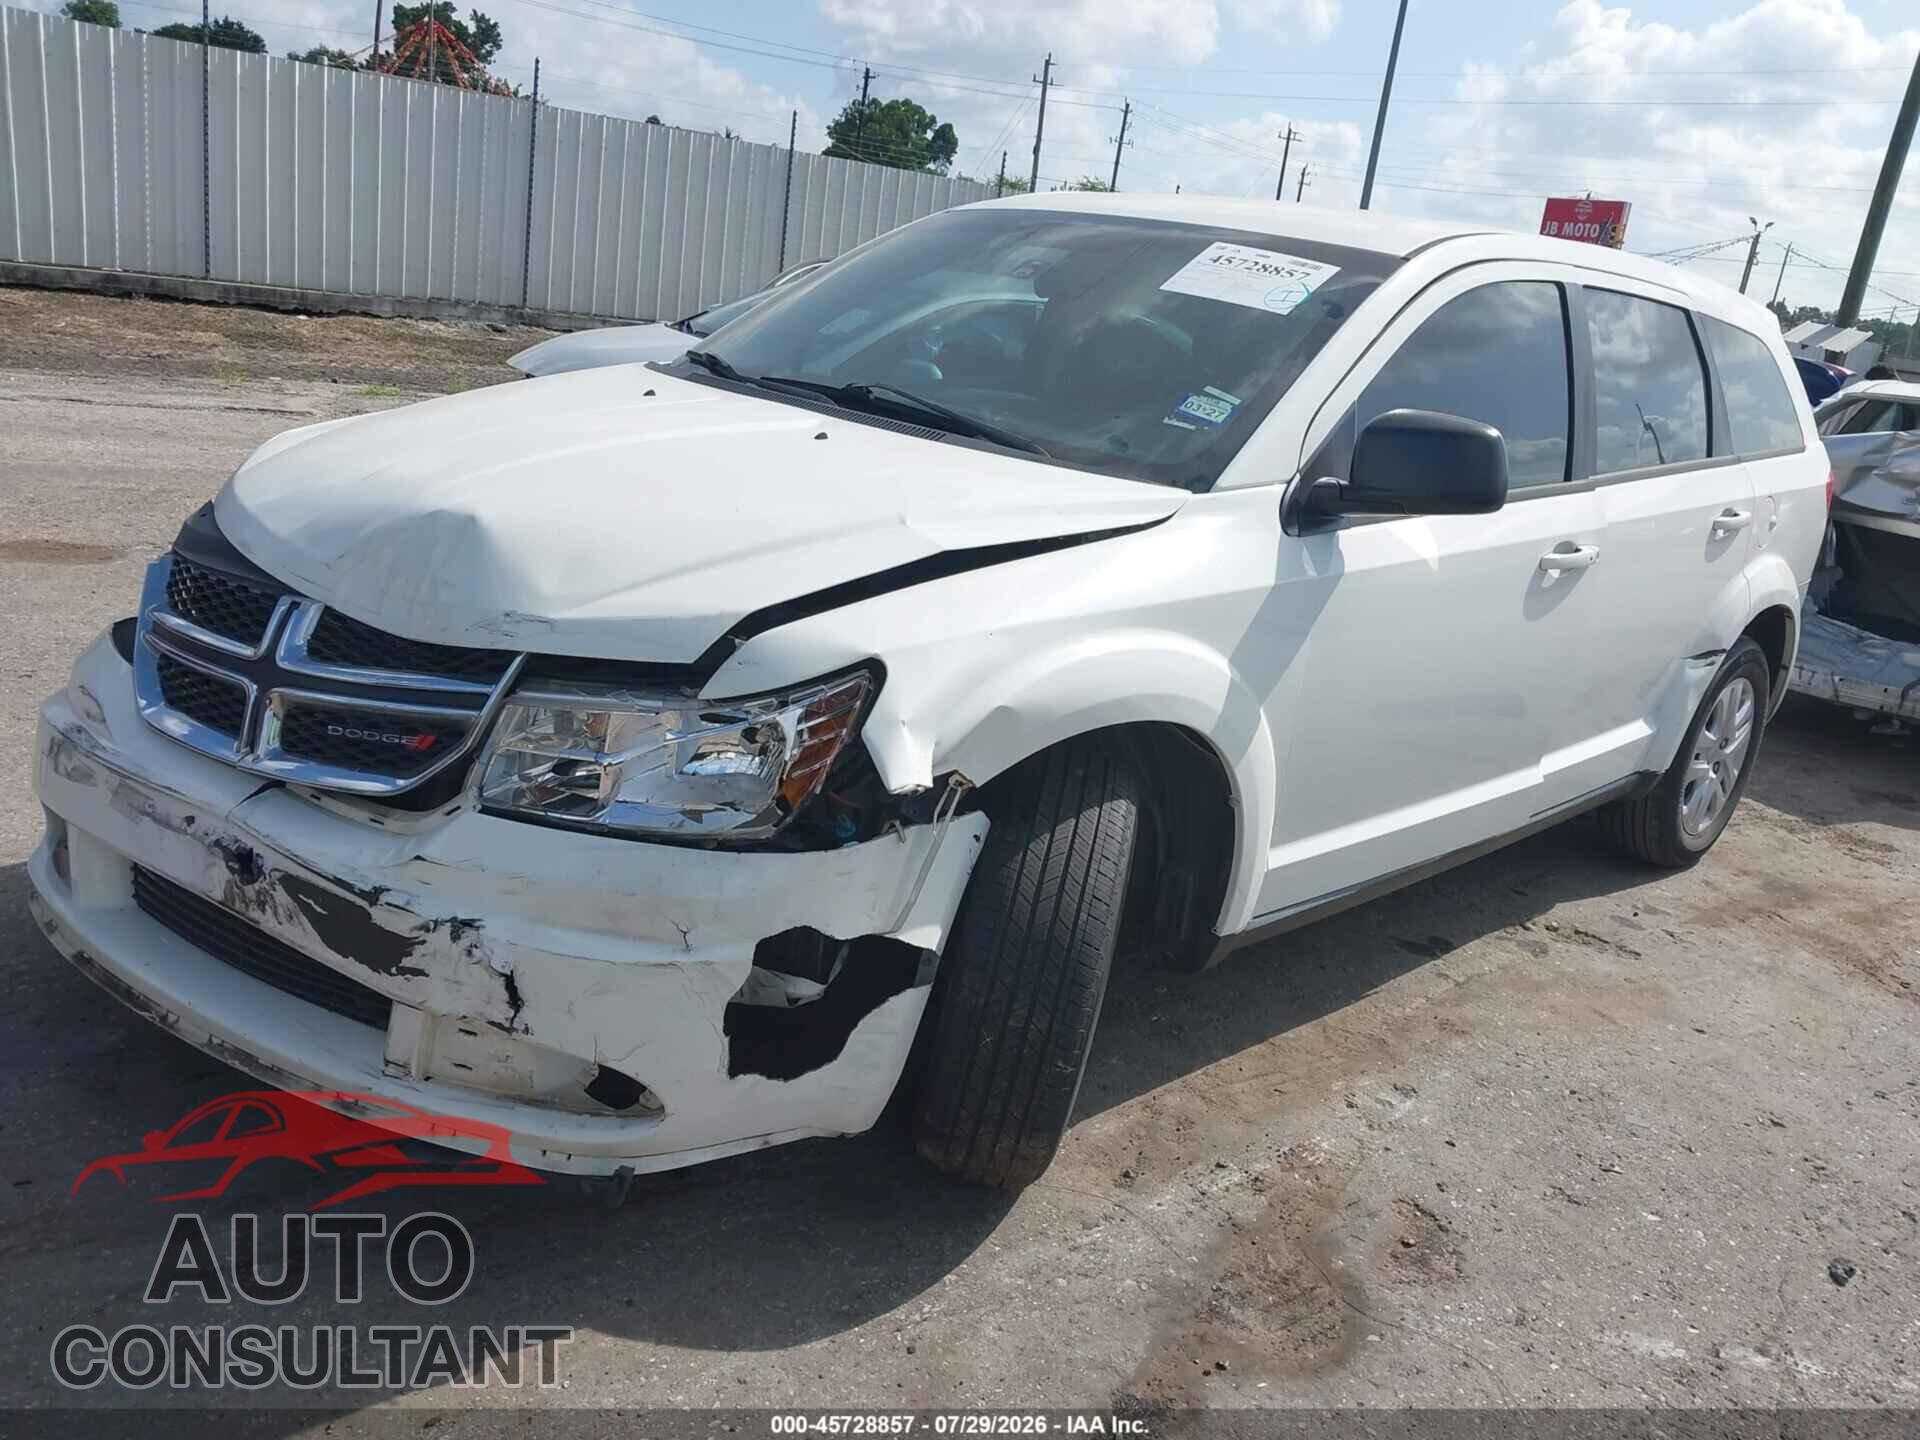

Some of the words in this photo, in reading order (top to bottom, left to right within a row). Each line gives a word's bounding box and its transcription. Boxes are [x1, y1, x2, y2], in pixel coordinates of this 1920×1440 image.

[1542, 220, 1560, 236] JB
[1562, 221, 1600, 238] MOTO
[1207, 255, 1311, 281] 45728857
[1183, 401, 1202, 412] 03
[1206, 408, 1226, 419] 27
[327, 725, 418, 746] DODGE
